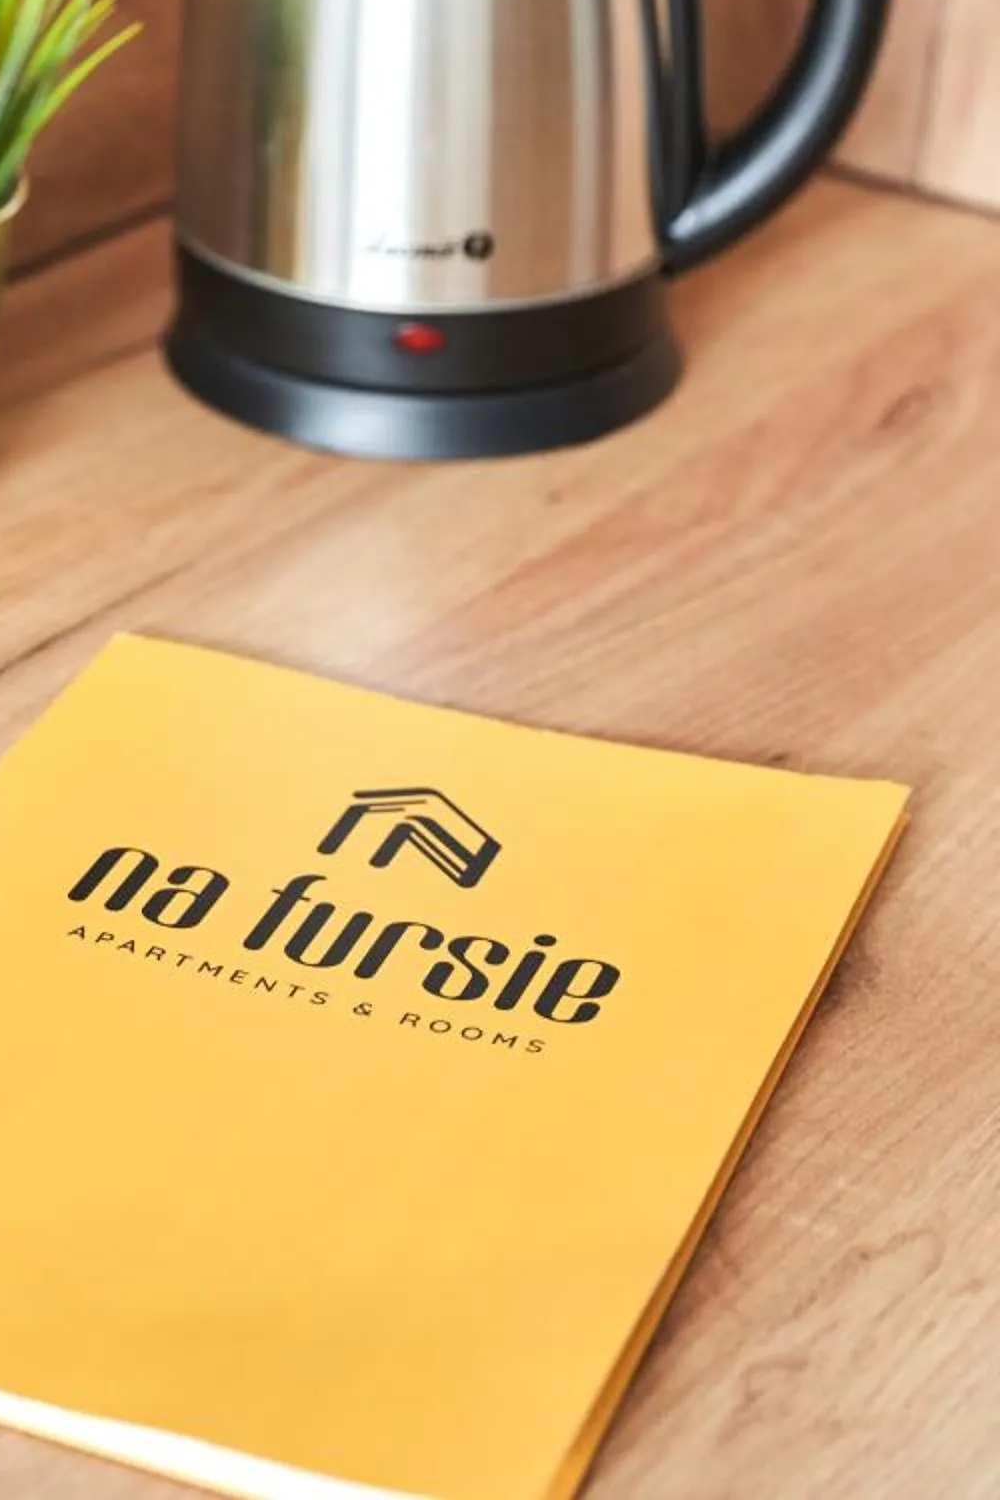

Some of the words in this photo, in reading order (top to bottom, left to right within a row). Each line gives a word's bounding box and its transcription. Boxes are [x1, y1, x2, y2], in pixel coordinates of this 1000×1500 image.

[66, 846, 230, 930] na
[242, 873, 622, 1025] fursie
[67, 924, 330, 1006] APARTMENTS
[353, 1002, 373, 1016] &
[398, 1012, 546, 1055] ROOMS
